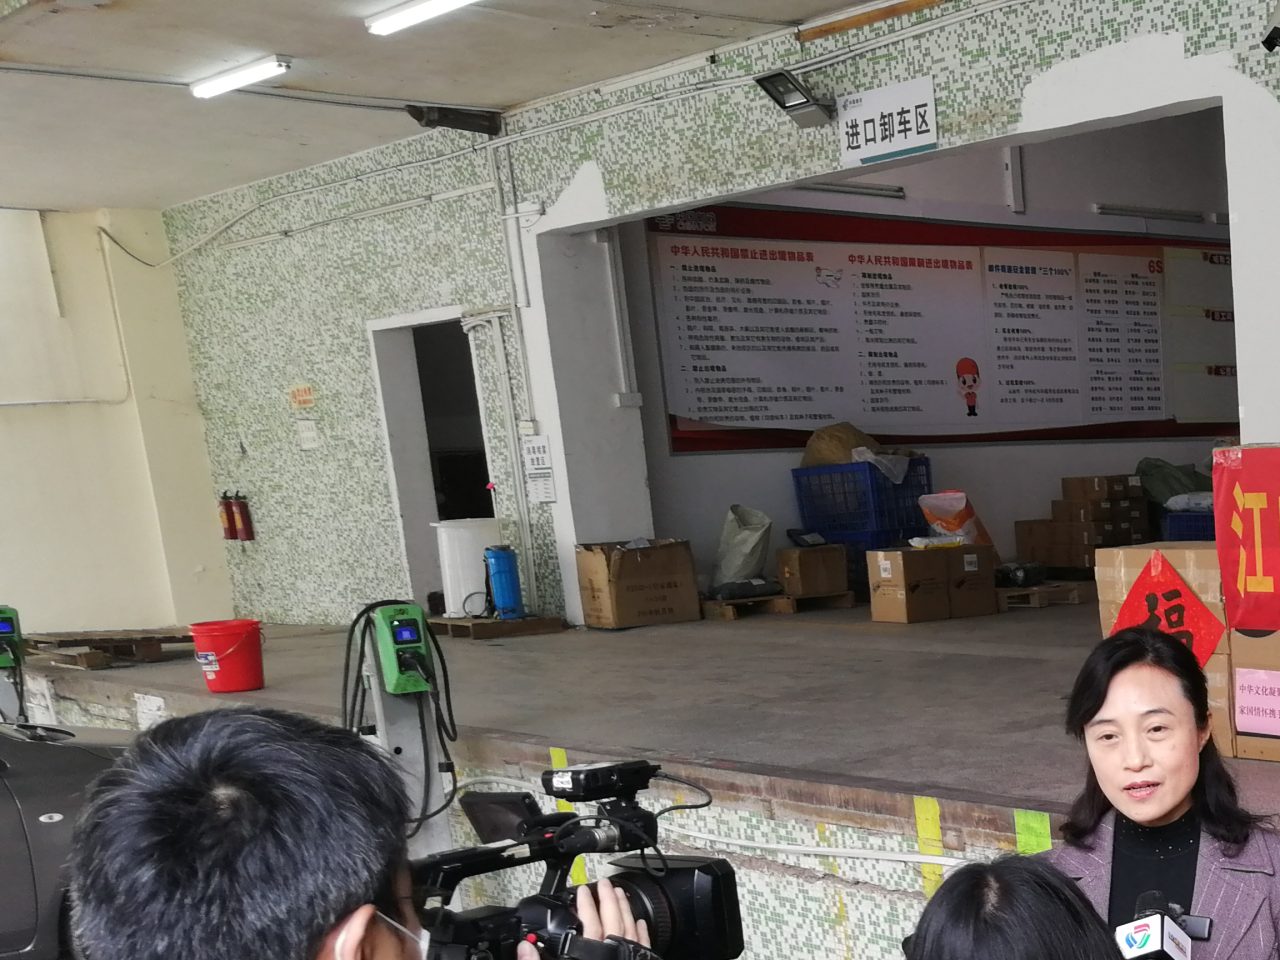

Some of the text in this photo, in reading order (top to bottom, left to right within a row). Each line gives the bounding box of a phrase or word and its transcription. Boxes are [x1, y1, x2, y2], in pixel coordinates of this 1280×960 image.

[845, 103, 931, 151] 进口卸车区
